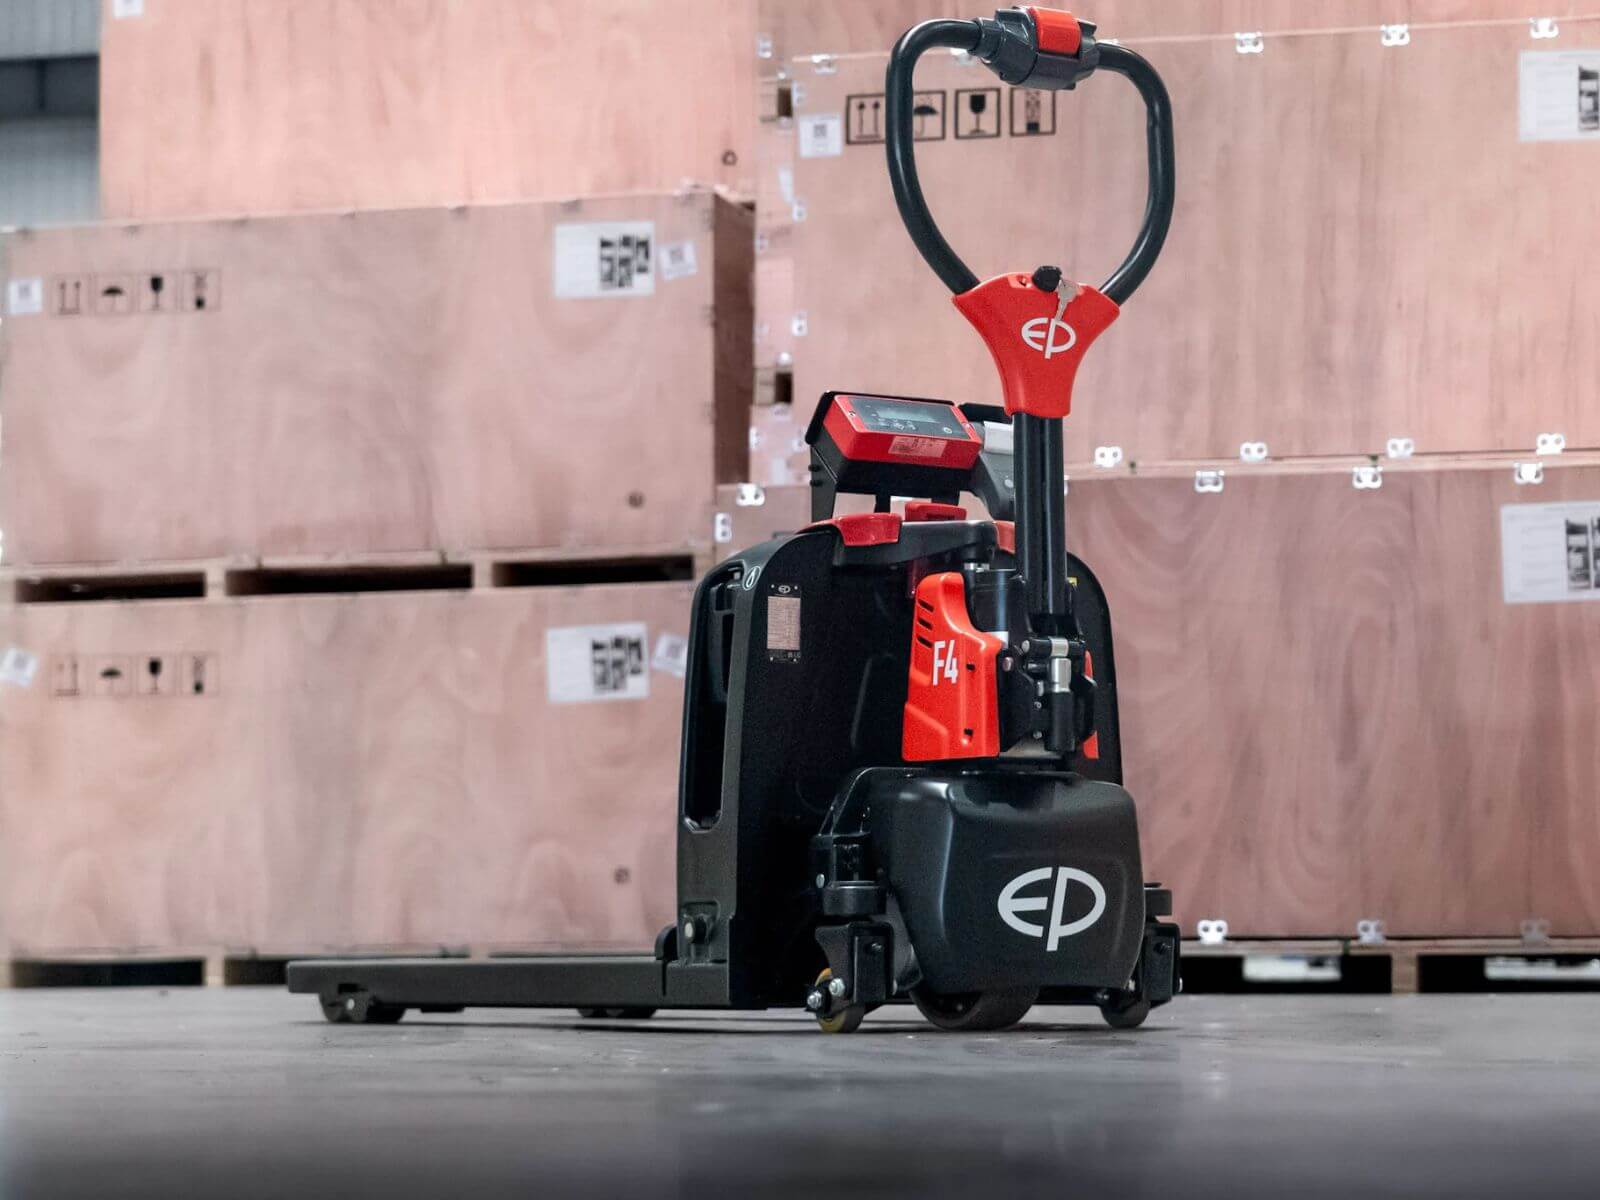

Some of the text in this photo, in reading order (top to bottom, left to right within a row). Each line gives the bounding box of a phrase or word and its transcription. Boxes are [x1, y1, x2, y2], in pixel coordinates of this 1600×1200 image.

[1021, 317, 1076, 359] EP
[932, 639, 959, 686] F4
[997, 866, 1106, 952] EP
